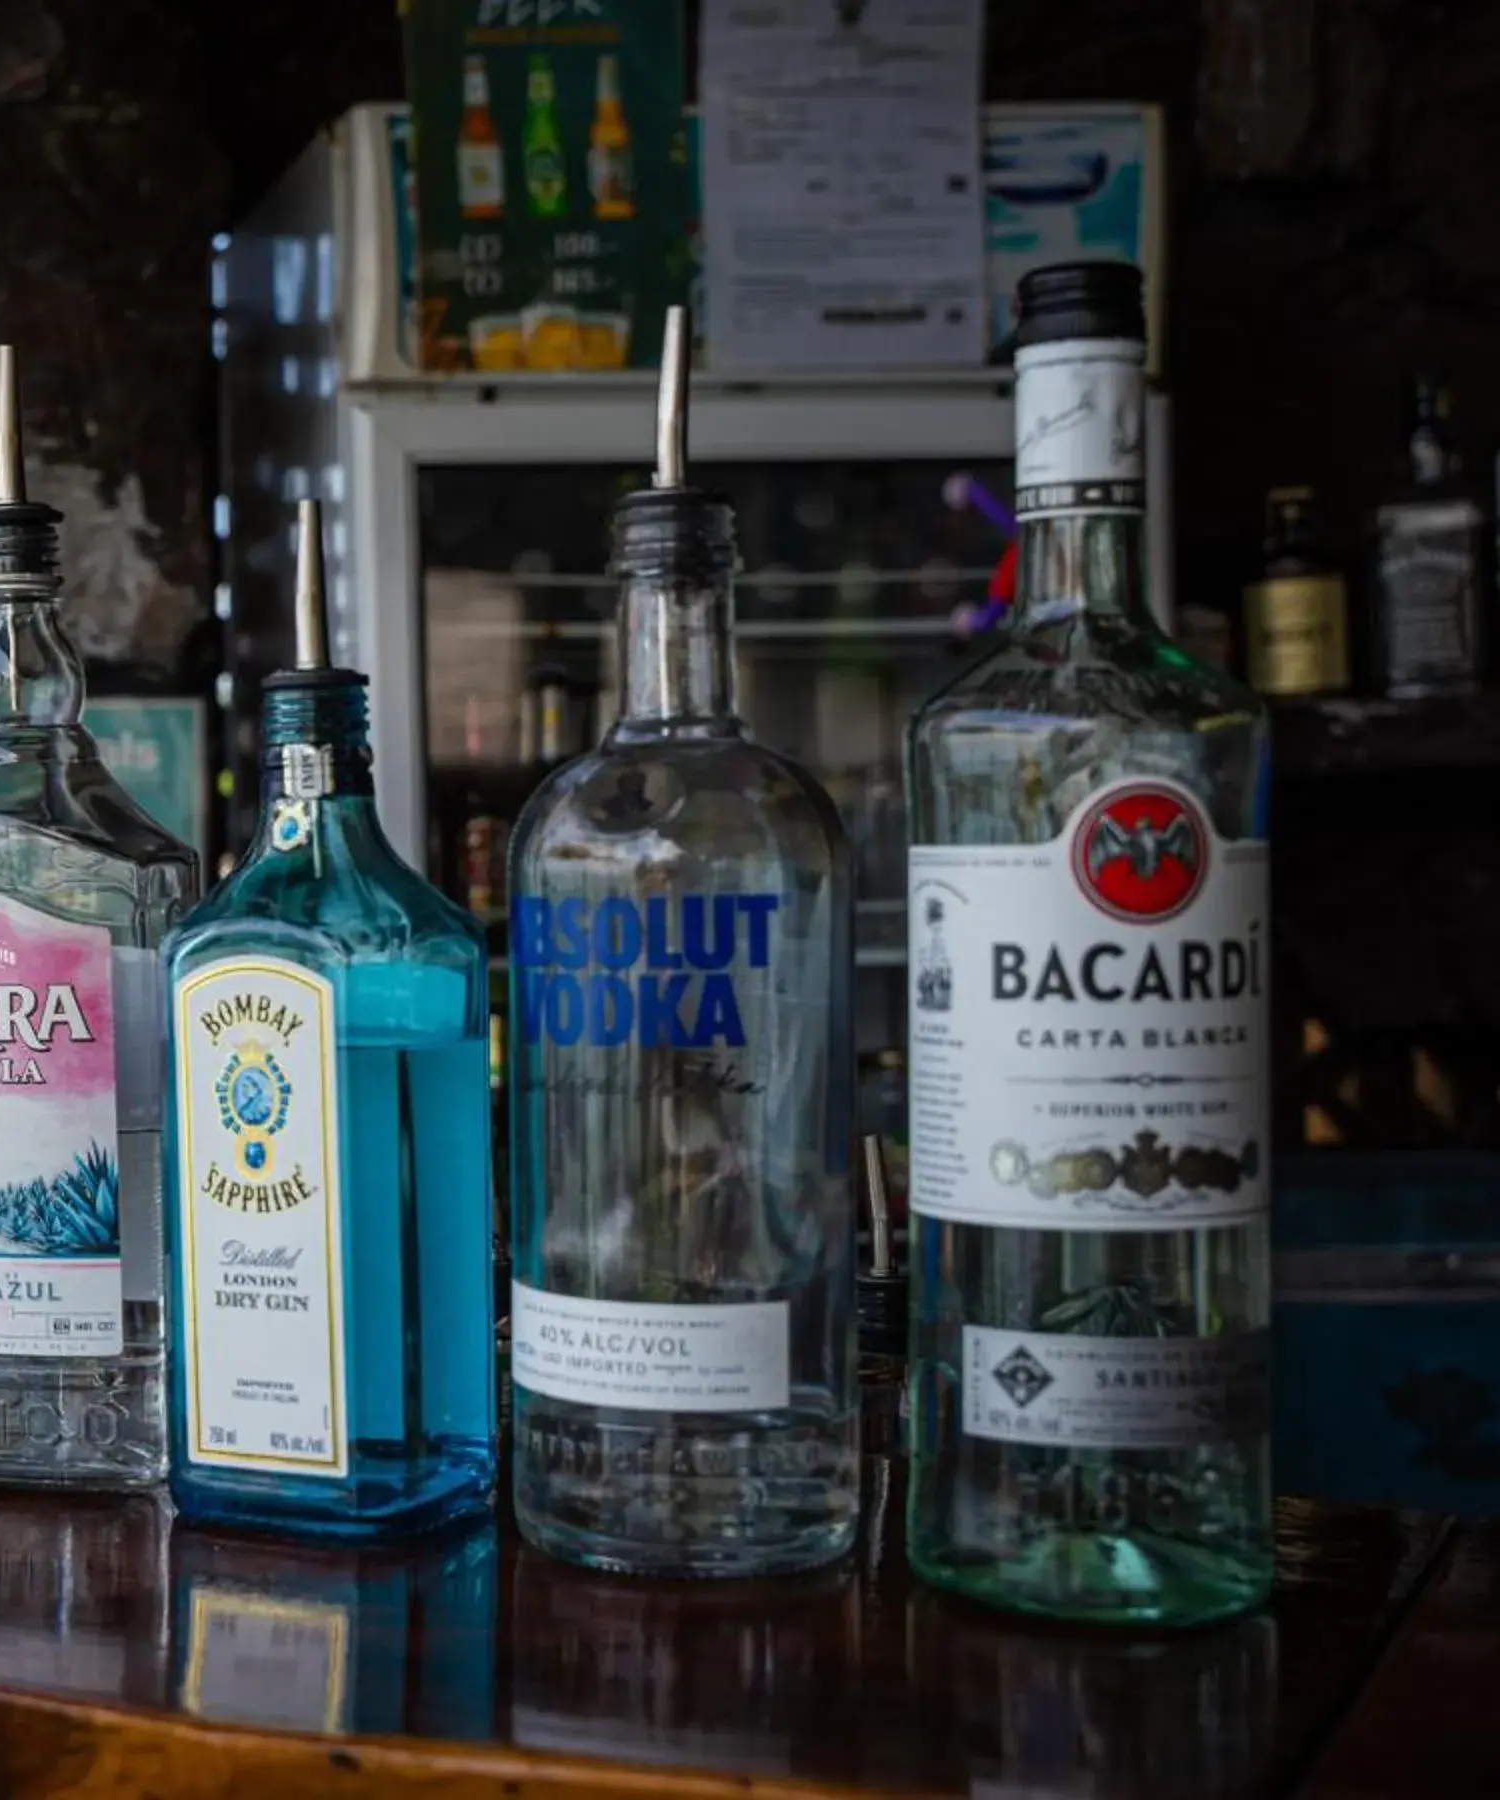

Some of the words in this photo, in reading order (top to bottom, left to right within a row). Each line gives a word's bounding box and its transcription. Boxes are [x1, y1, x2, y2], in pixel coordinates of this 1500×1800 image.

[512, 894, 778, 970] BSOLUT
[201, 994, 304, 1038] BOMBAY
[1016, 1028, 1127, 1049] CARTA
[1142, 1025, 1250, 1049] BLANCA
[202, 1165, 312, 1214] SAPPHIRE
[218, 1239, 304, 1270] Distilled
[223, 1272, 299, 1288] LONDON
[214, 1290, 260, 1308] DRY
[264, 1294, 309, 1312] GIN
[540, 1323, 575, 1349] 40%
